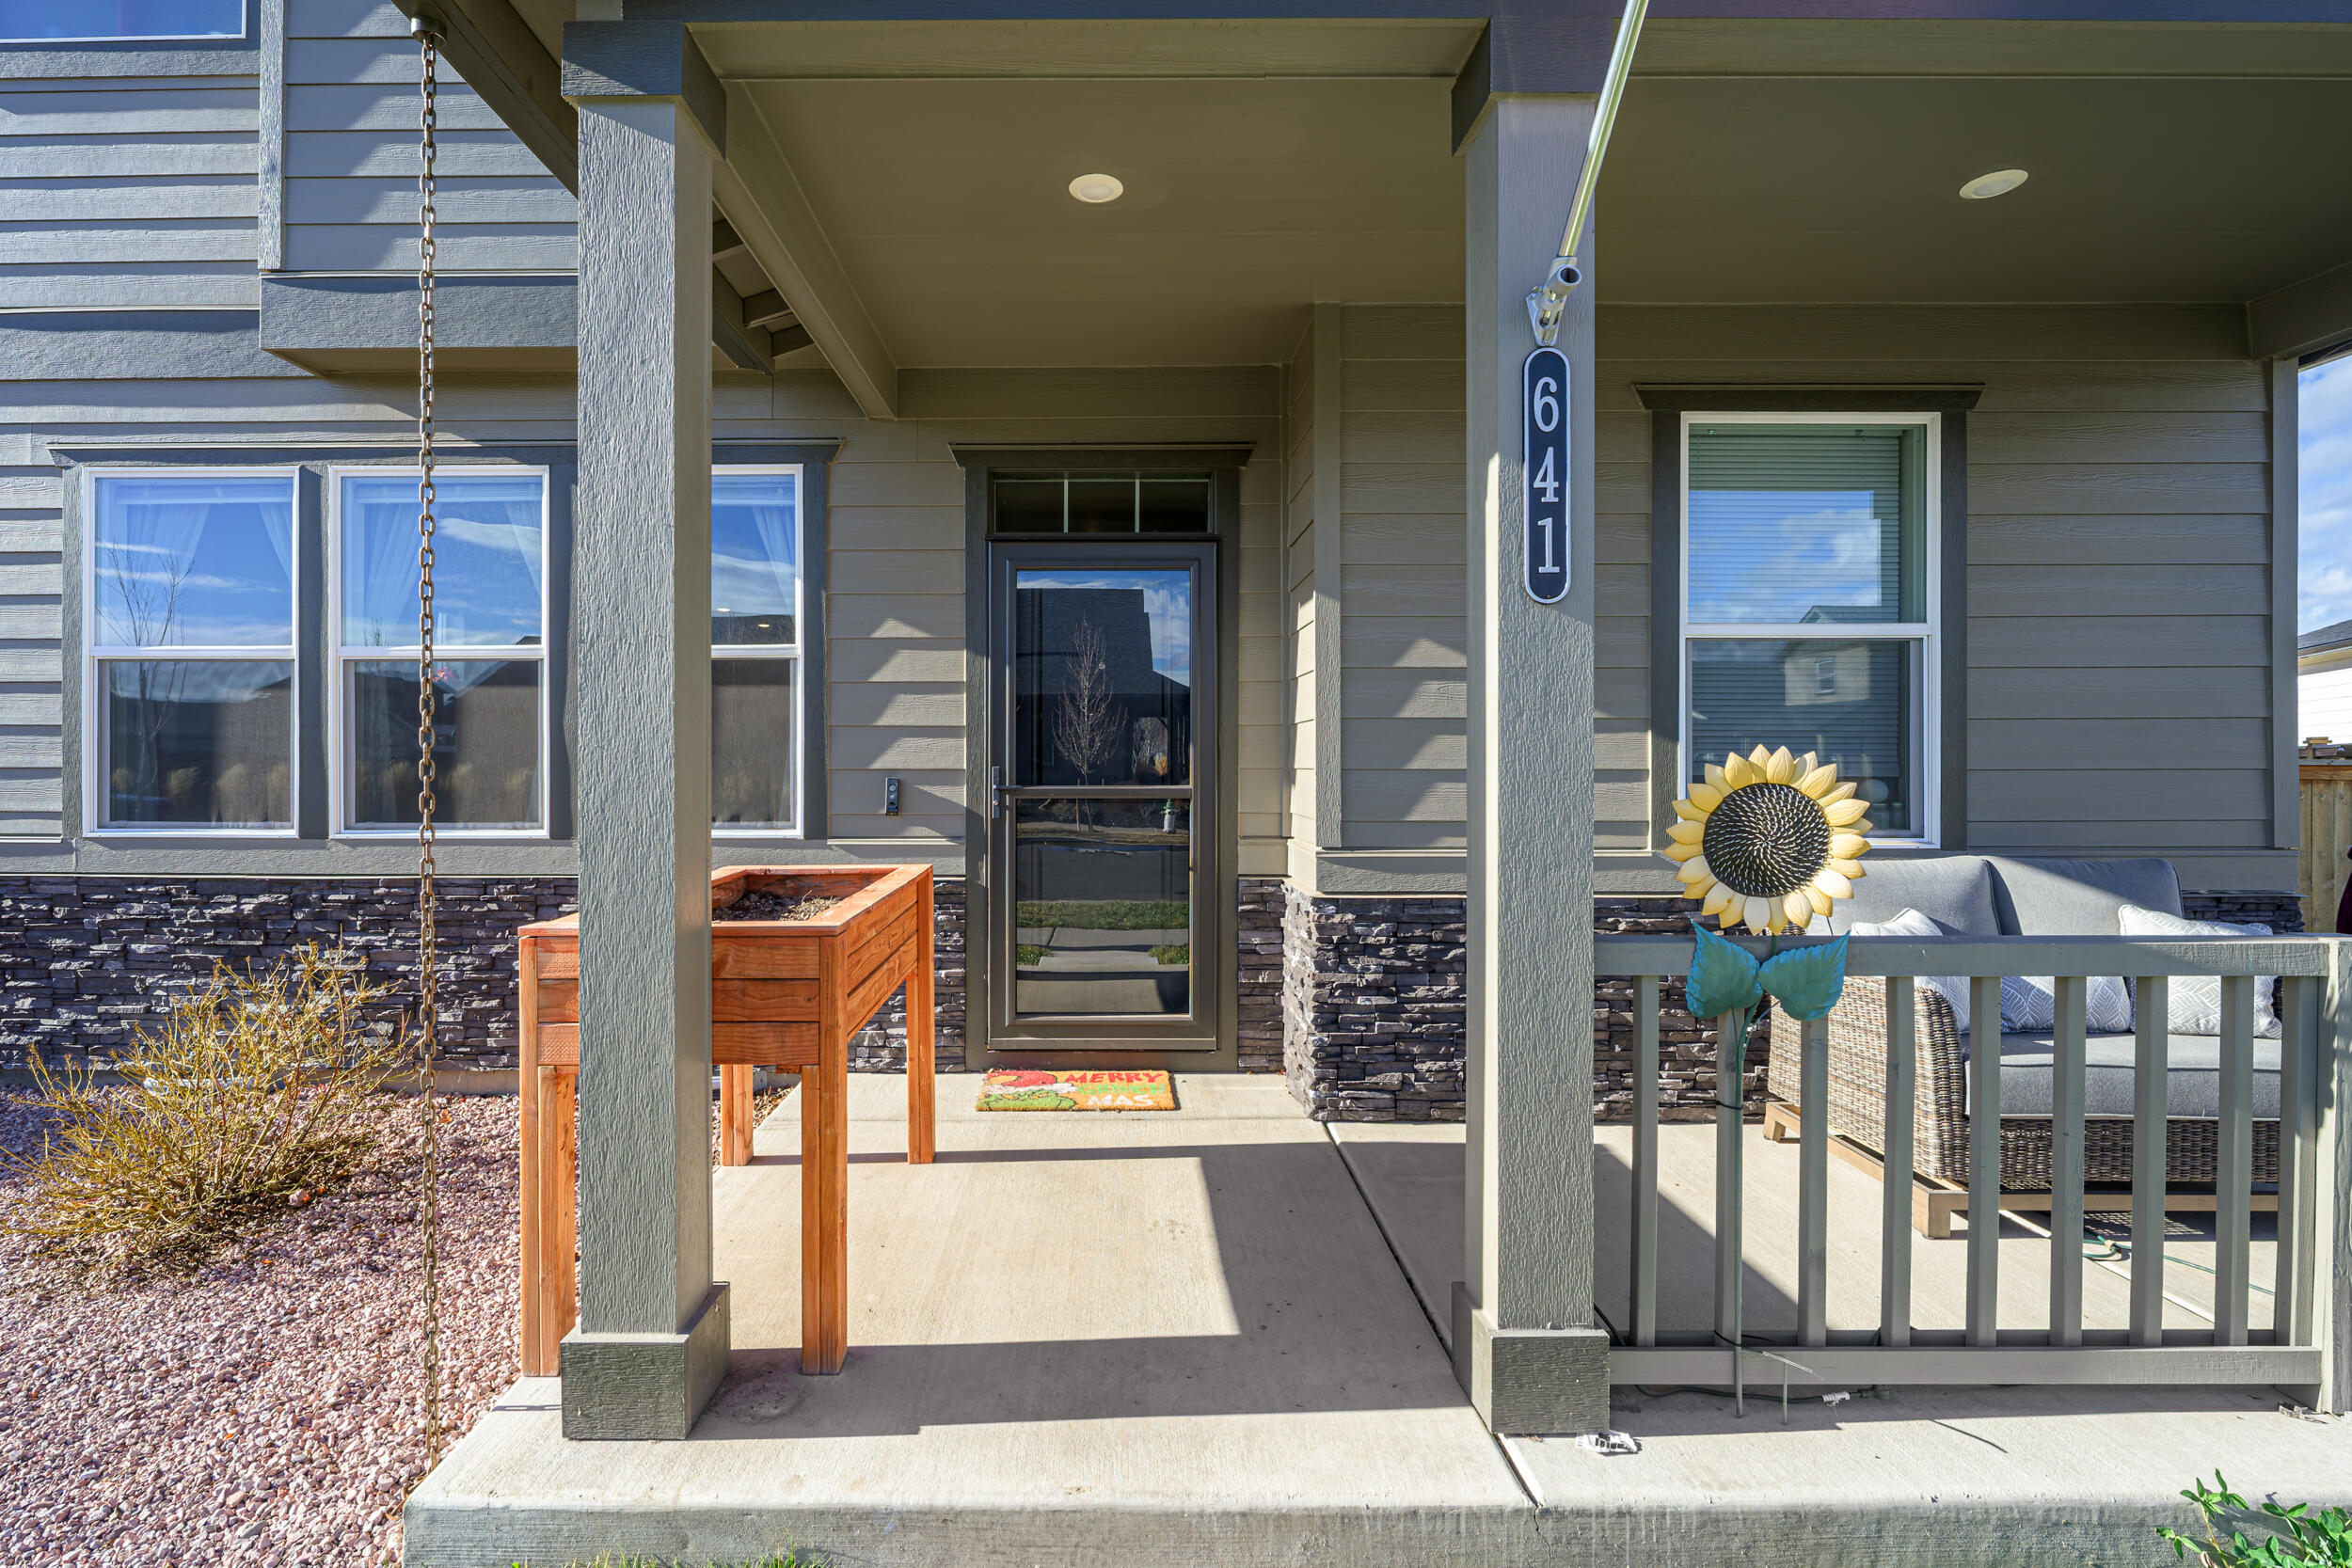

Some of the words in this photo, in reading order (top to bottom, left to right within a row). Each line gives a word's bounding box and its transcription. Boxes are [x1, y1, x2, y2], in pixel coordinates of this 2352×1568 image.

[1533, 376, 1560, 574] 641
[1065, 1072, 1164, 1083] MERRY
[1087, 1094, 1154, 1106] MAS
